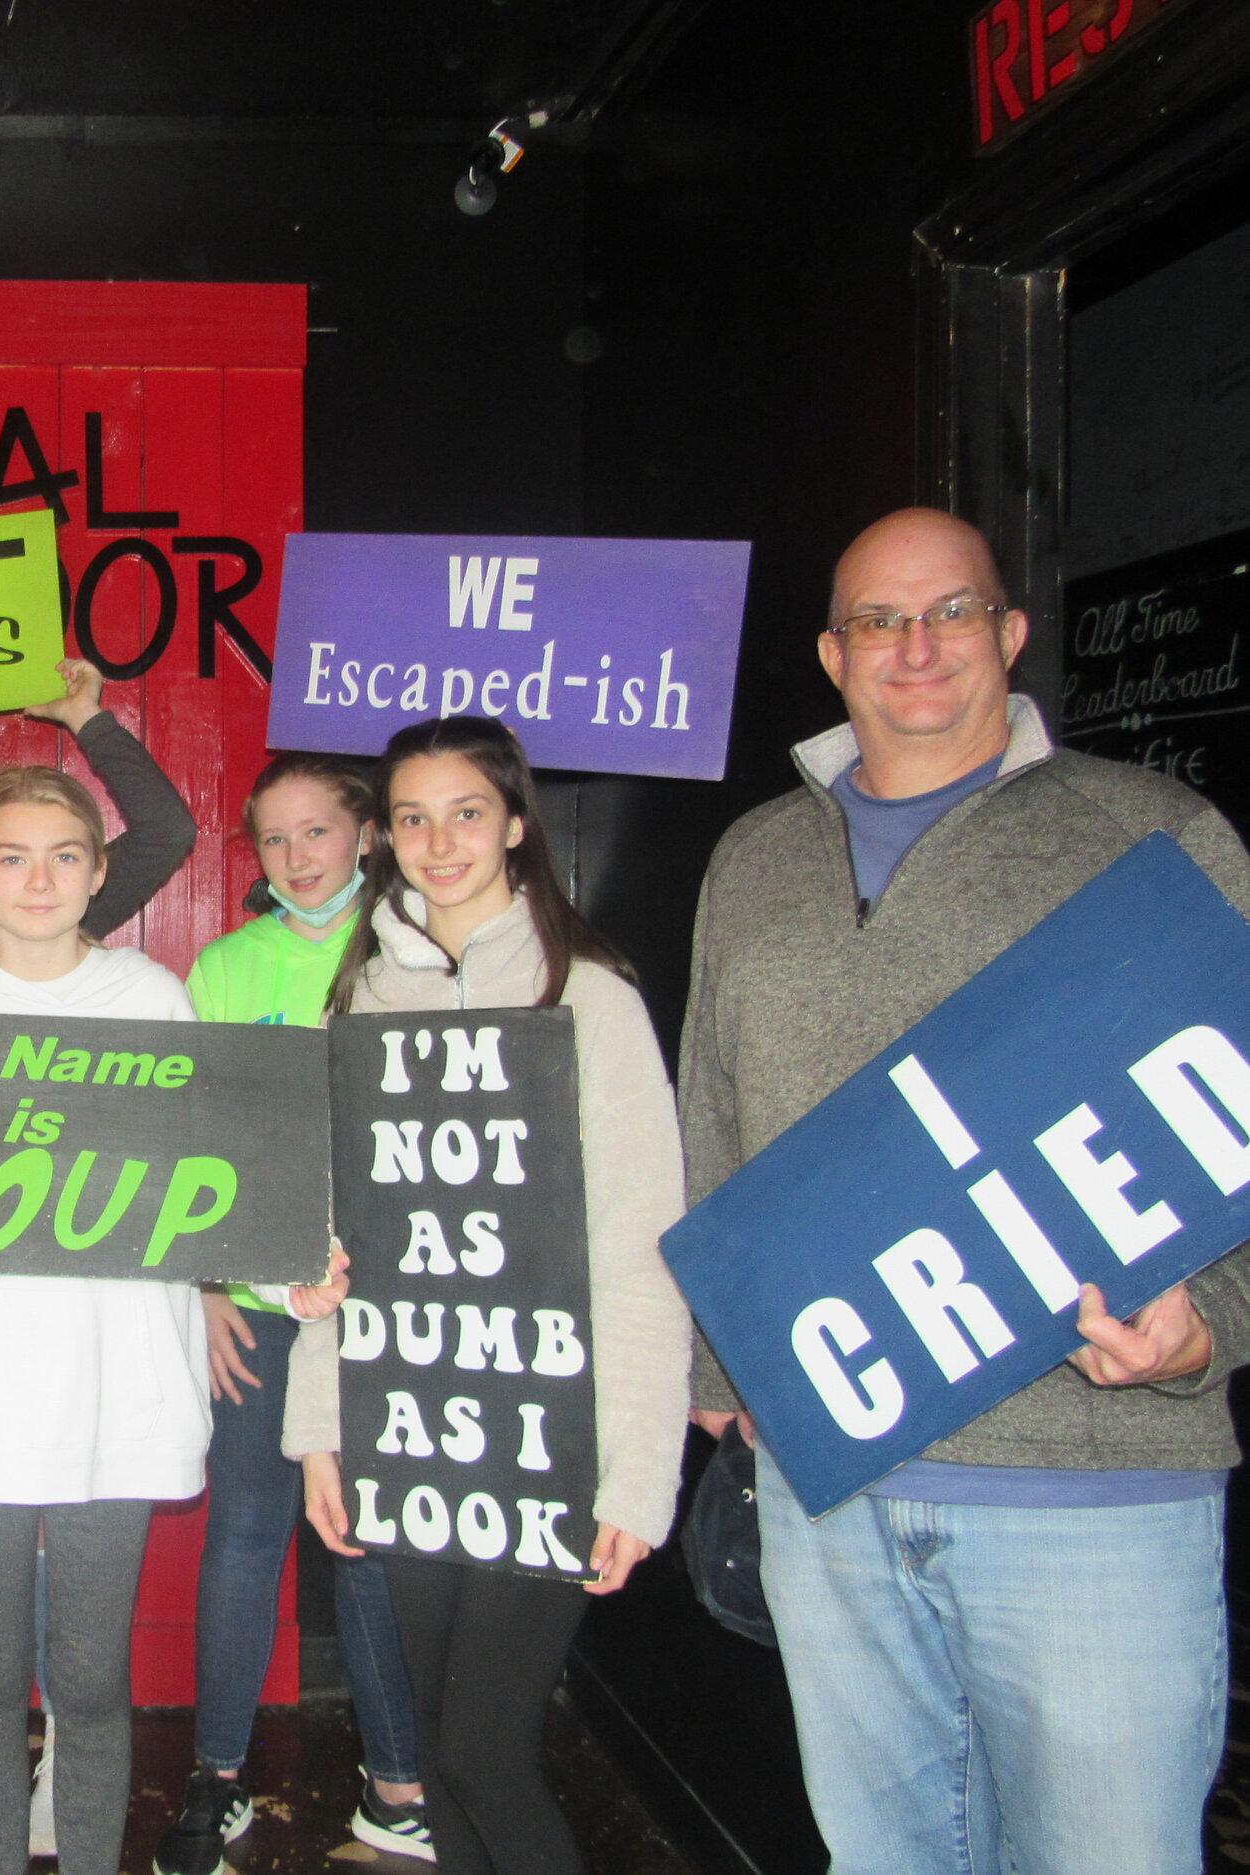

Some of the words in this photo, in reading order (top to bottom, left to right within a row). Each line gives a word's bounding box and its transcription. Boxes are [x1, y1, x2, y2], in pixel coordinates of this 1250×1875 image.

[449, 555, 539, 631] WE
[1075, 599, 1126, 657] All
[1131, 588, 1199, 643] Time
[304, 639, 690, 730] Escaped-ish
[1061, 632, 1240, 723] Leaderboard
[0, 1034, 195, 1089] Name
[380, 1027, 509, 1093] I'M
[3, 1097, 66, 1145] is
[887, 1053, 982, 1171] I
[370, 1118, 528, 1185] NOT
[398, 1210, 505, 1277] AS
[790, 1024, 1250, 1441] CRIED
[339, 1298, 586, 1377] DUMB
[375, 1390, 486, 1464] AS
[517, 1403, 551, 1471] I
[353, 1478, 583, 1573] LOOK
